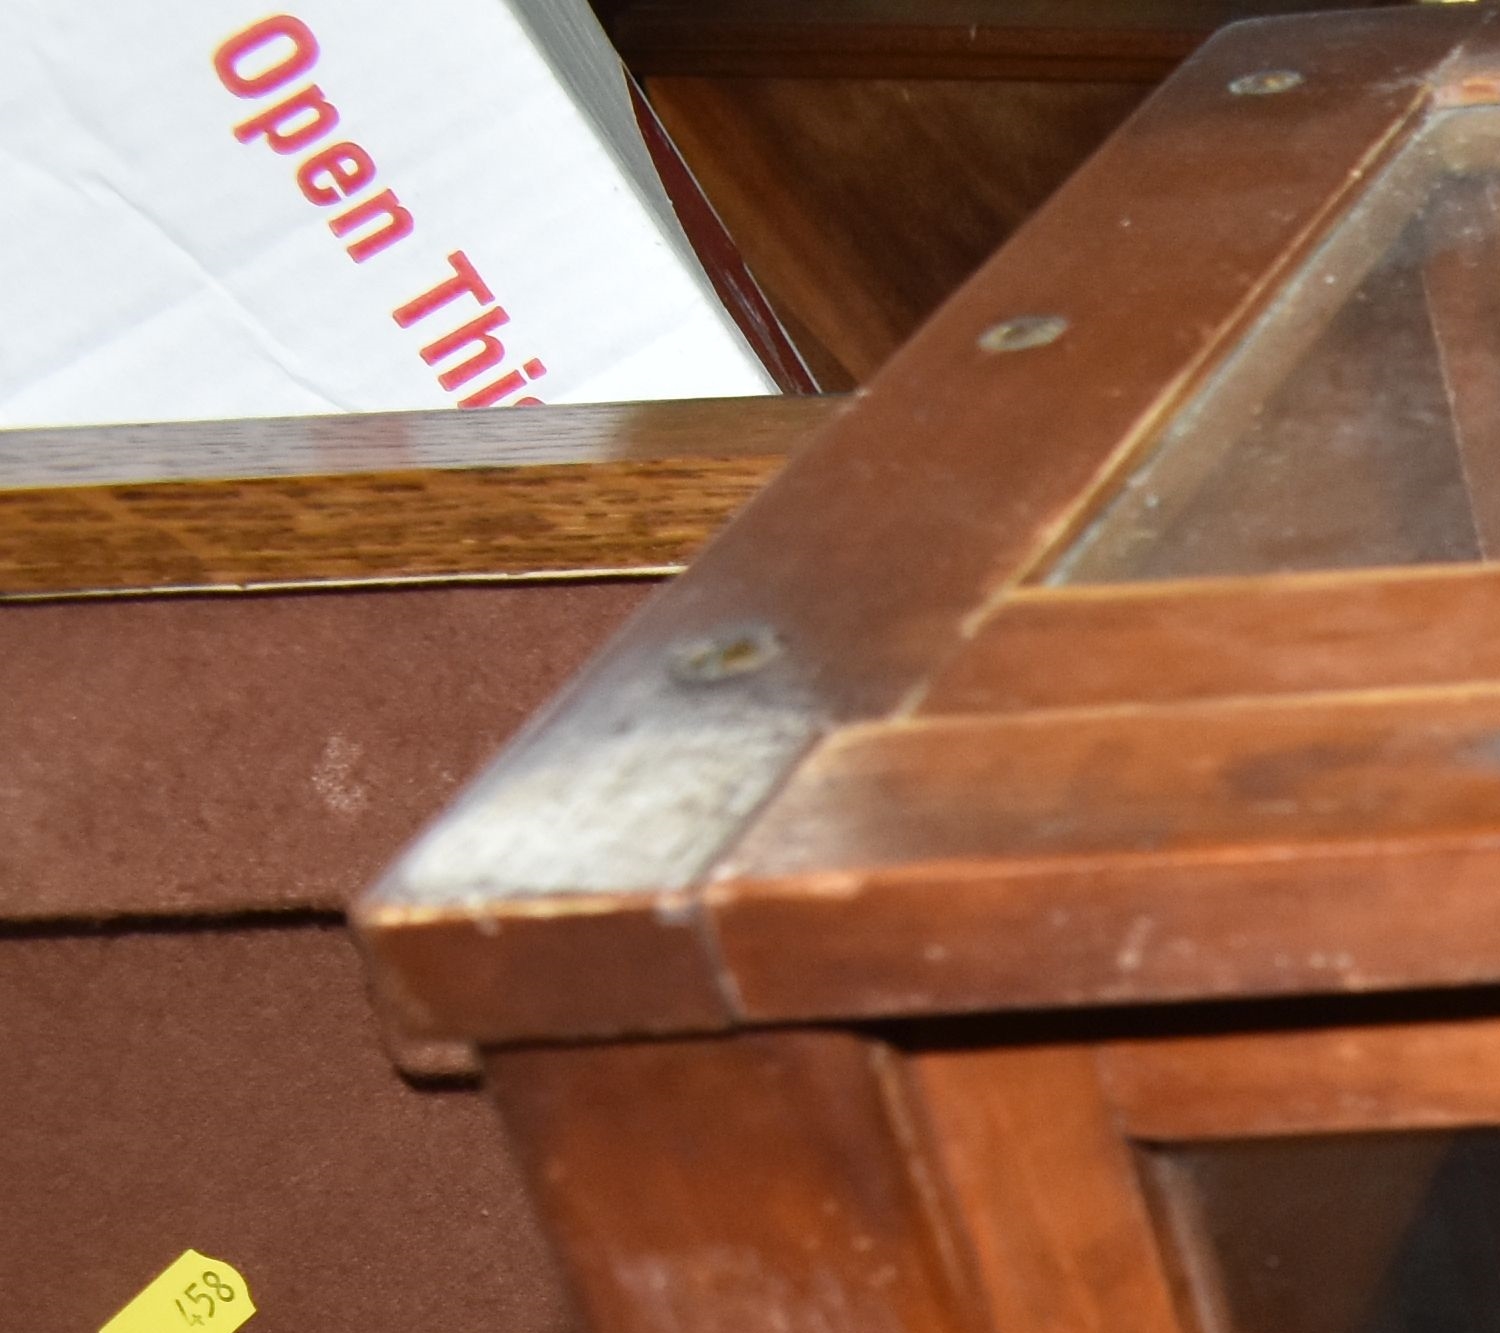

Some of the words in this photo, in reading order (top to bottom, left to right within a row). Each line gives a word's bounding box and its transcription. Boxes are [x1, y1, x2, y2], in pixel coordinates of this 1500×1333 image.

[213, 14, 415, 265] Open
[391, 250, 547, 408] Thi
[175, 1270, 235, 1327] 458
